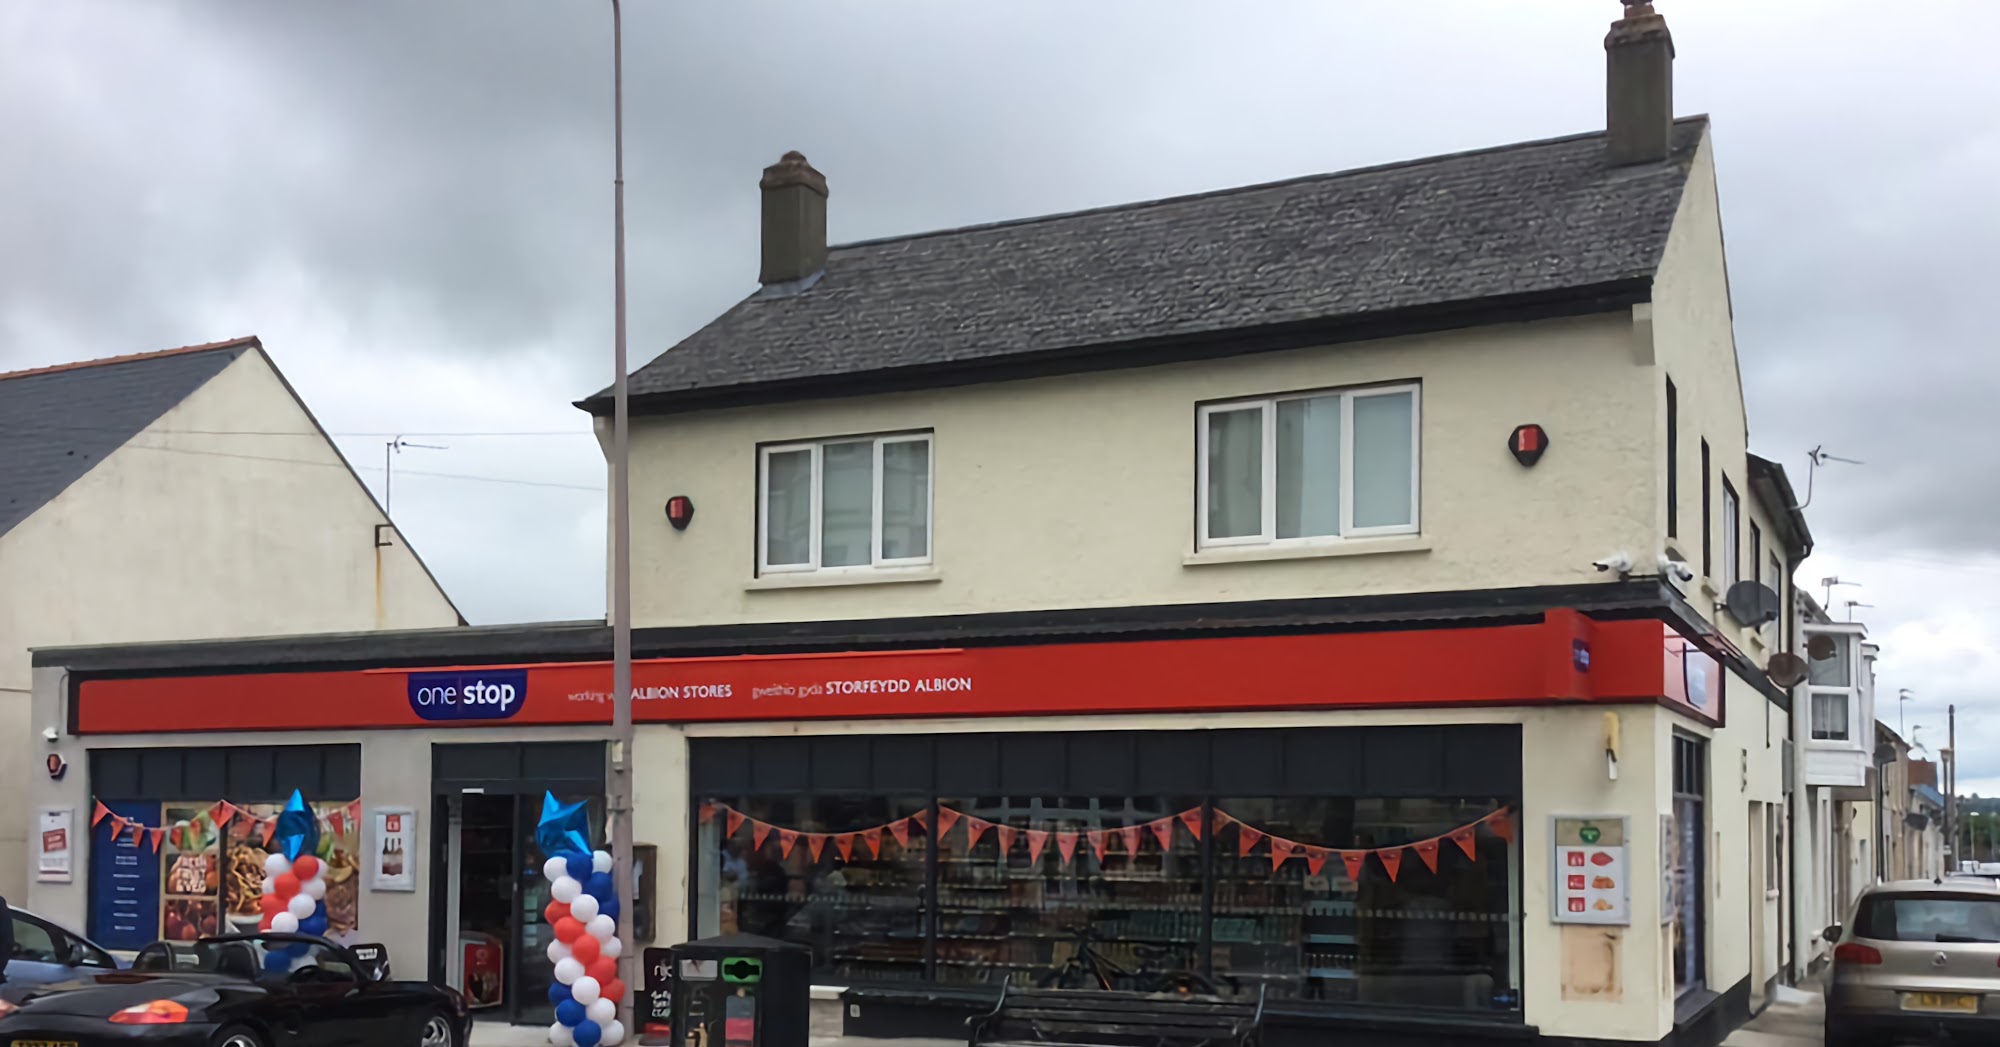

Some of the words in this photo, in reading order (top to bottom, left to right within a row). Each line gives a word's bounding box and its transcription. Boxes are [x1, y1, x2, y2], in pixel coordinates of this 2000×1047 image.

[417, 687, 457, 706] one
[464, 680, 516, 711] stop
[630, 687, 679, 699] ALBION
[682, 684, 733, 698] STORES
[826, 681, 910, 696] STORFEYDD
[915, 677, 973, 693] ALBION
